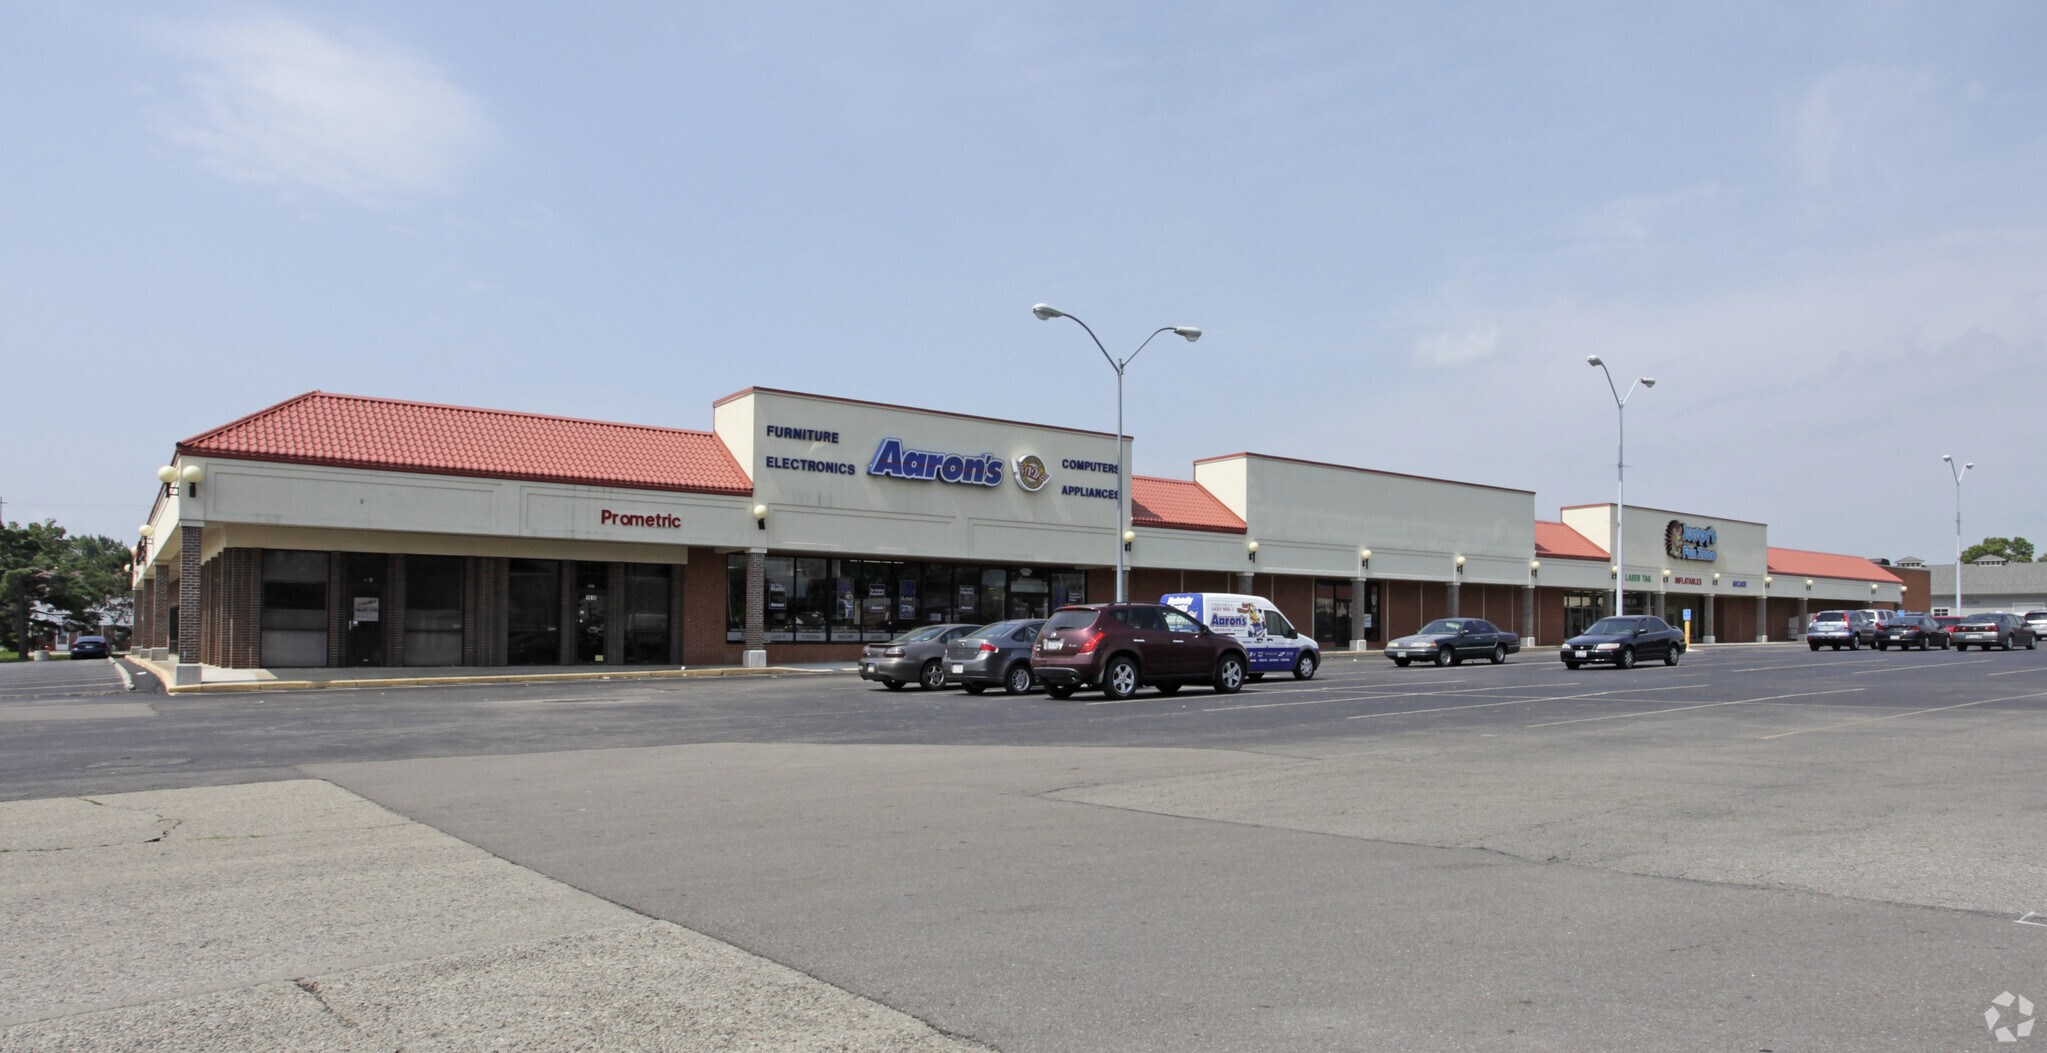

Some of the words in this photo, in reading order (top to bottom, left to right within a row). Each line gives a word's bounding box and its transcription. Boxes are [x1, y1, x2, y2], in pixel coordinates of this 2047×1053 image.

[766, 425, 839, 444] FURNITURE
[766, 456, 856, 475] ELECTRONICS
[868, 438, 1004, 487] Aaron's
[601, 509, 681, 528] Prometric
[1625, 574, 1641, 582] LASER
[1642, 575, 1652, 583] TAG
[1675, 577, 1702, 586] INFLATABLES
[1732, 580, 1747, 588] ARCADE
[1211, 613, 1247, 627] Aaron's
